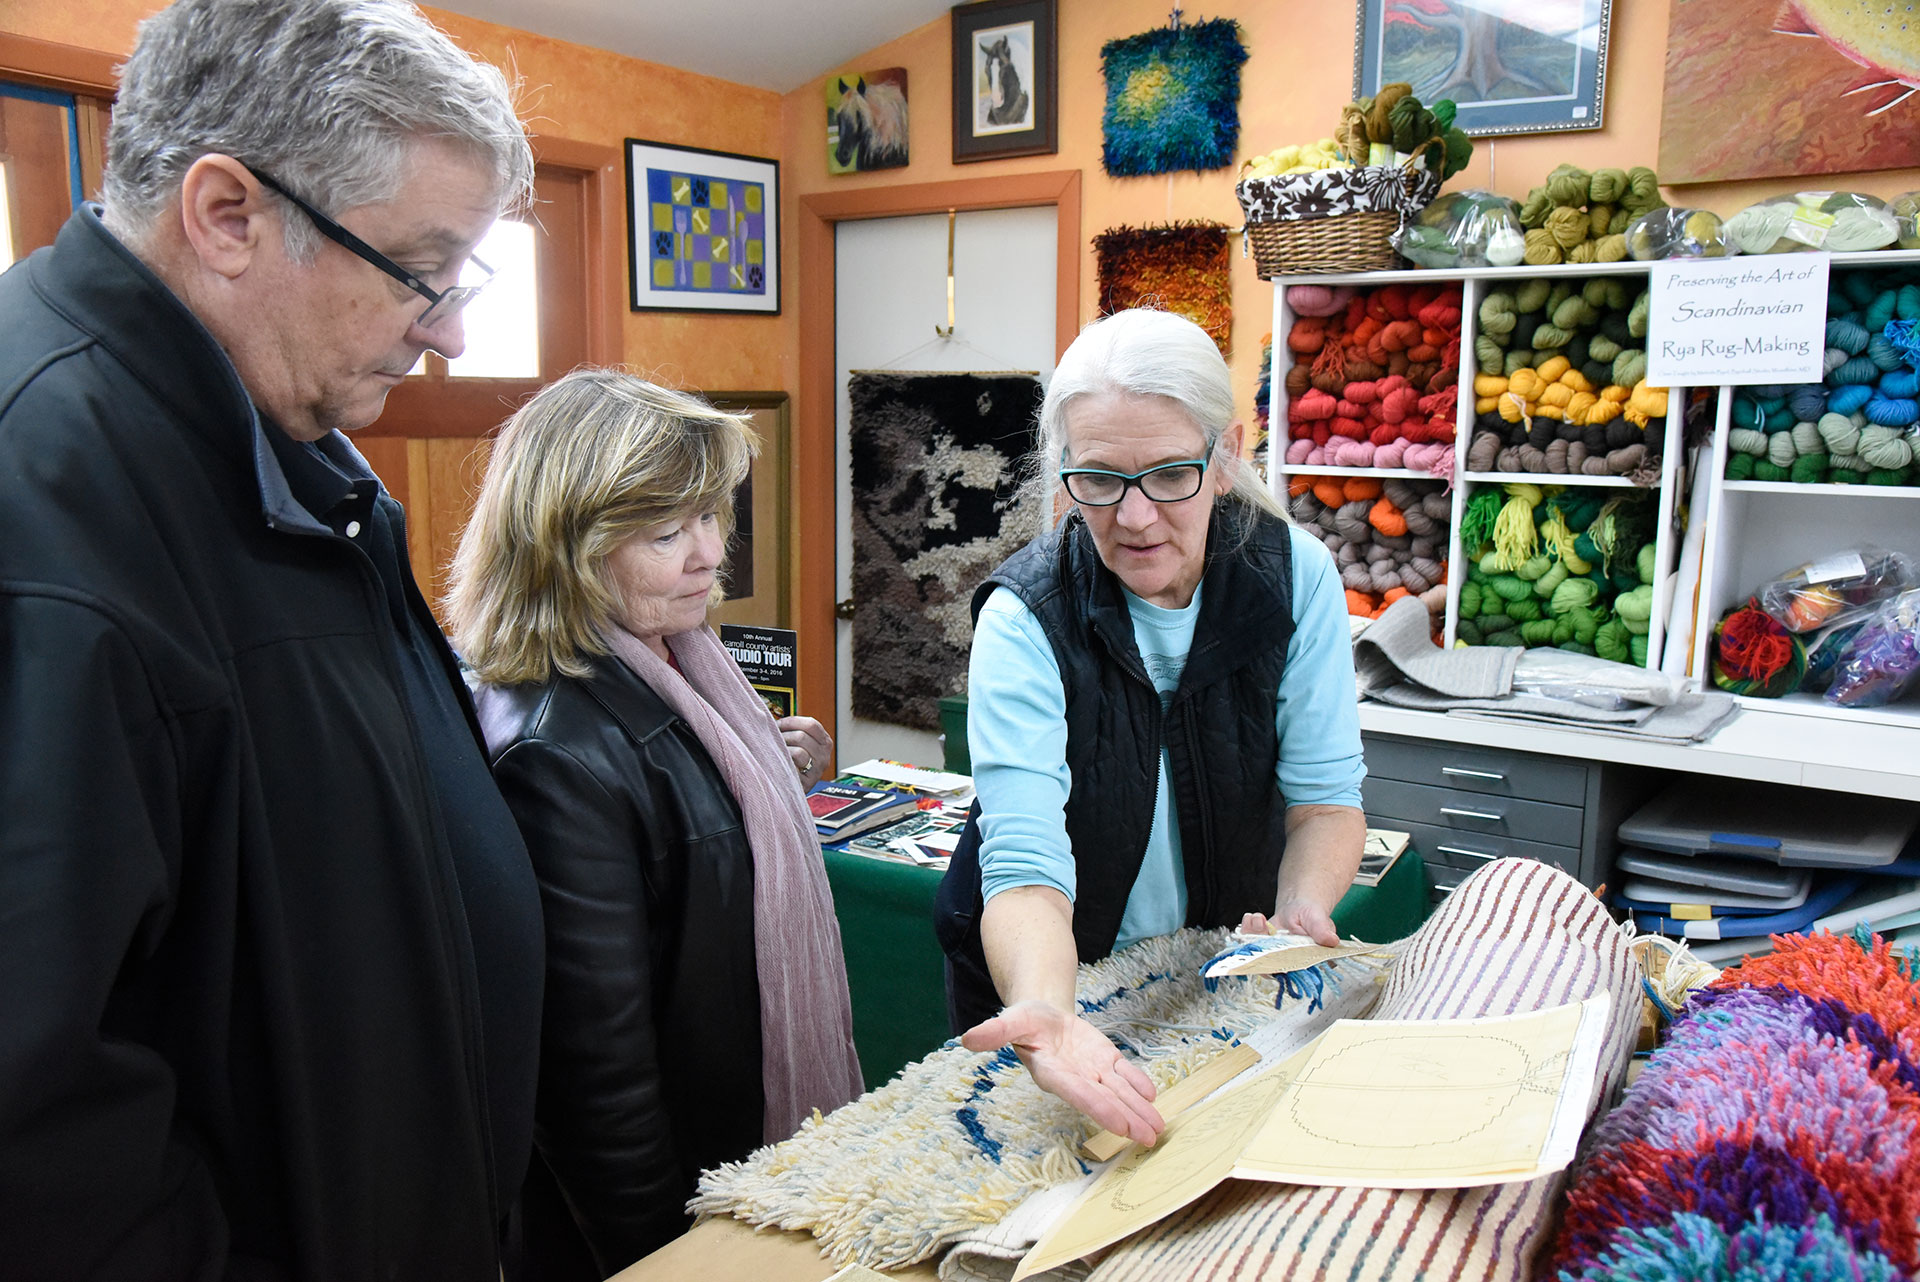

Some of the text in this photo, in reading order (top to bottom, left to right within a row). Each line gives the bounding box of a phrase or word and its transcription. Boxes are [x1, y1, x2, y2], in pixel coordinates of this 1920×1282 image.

[1667, 265, 1817, 289] Preserving the Art of
[1672, 299, 1804, 323] Scandinavian
[1662, 335, 1810, 361] Rya Rug-Making
[745, 643, 769, 651] county
[763, 651, 792, 667] TOUR
